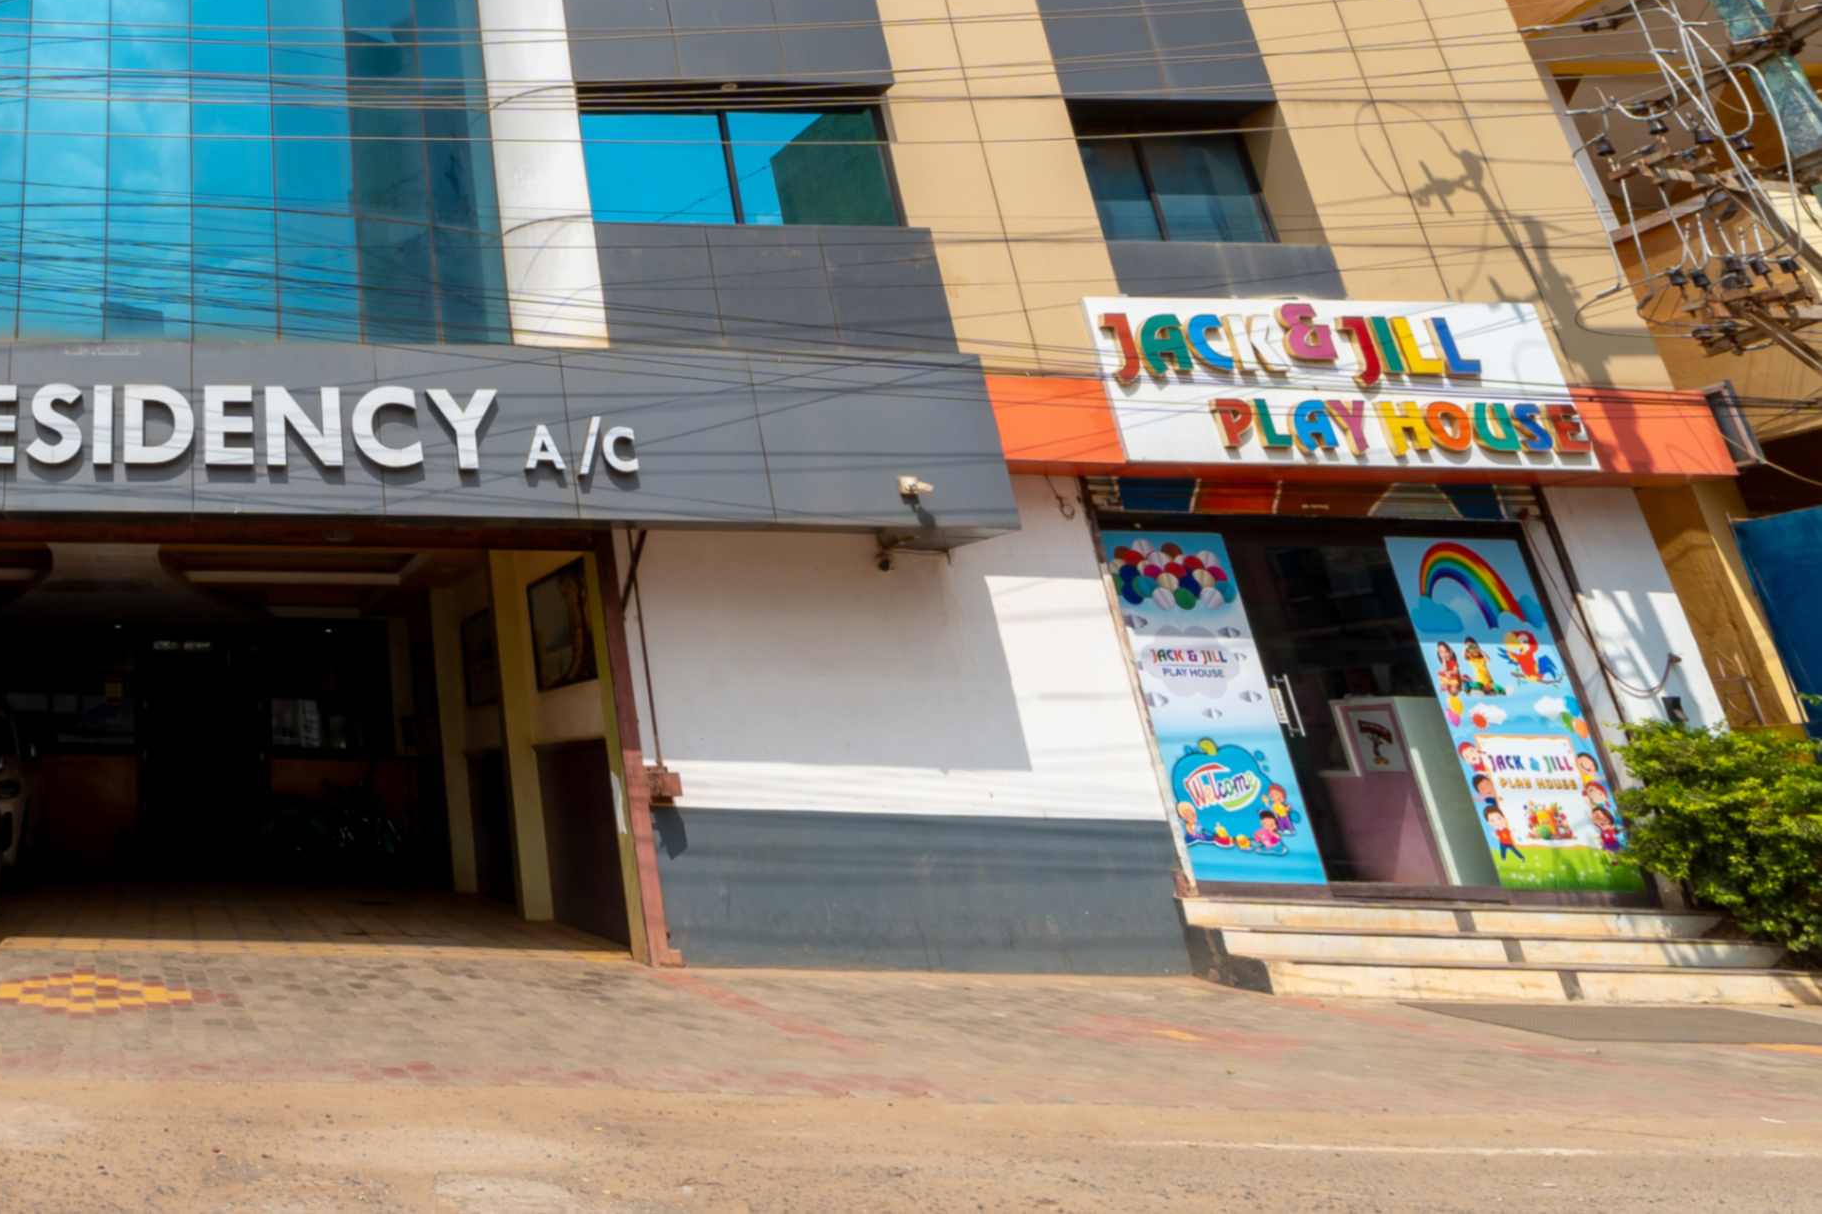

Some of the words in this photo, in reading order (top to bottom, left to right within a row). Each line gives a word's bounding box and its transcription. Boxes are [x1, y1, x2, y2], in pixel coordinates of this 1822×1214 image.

[1098, 313, 1291, 384] JACK
[1275, 303, 1339, 363] &
[1334, 316, 1482, 388] JILL
[1208, 398, 1369, 457] PLAY
[1372, 401, 1593, 457] HOUSE
[1150, 649, 1185, 664] JACK
[1187, 649, 1198, 662] &
[1201, 649, 1228, 665] JILL
[1162, 667, 1187, 678] PLAY
[1189, 668, 1225, 678] HOUSE
[1488, 754, 1525, 772] JACK
[1543, 754, 1574, 774] JILL
[1185, 763, 1258, 807] Welcome
